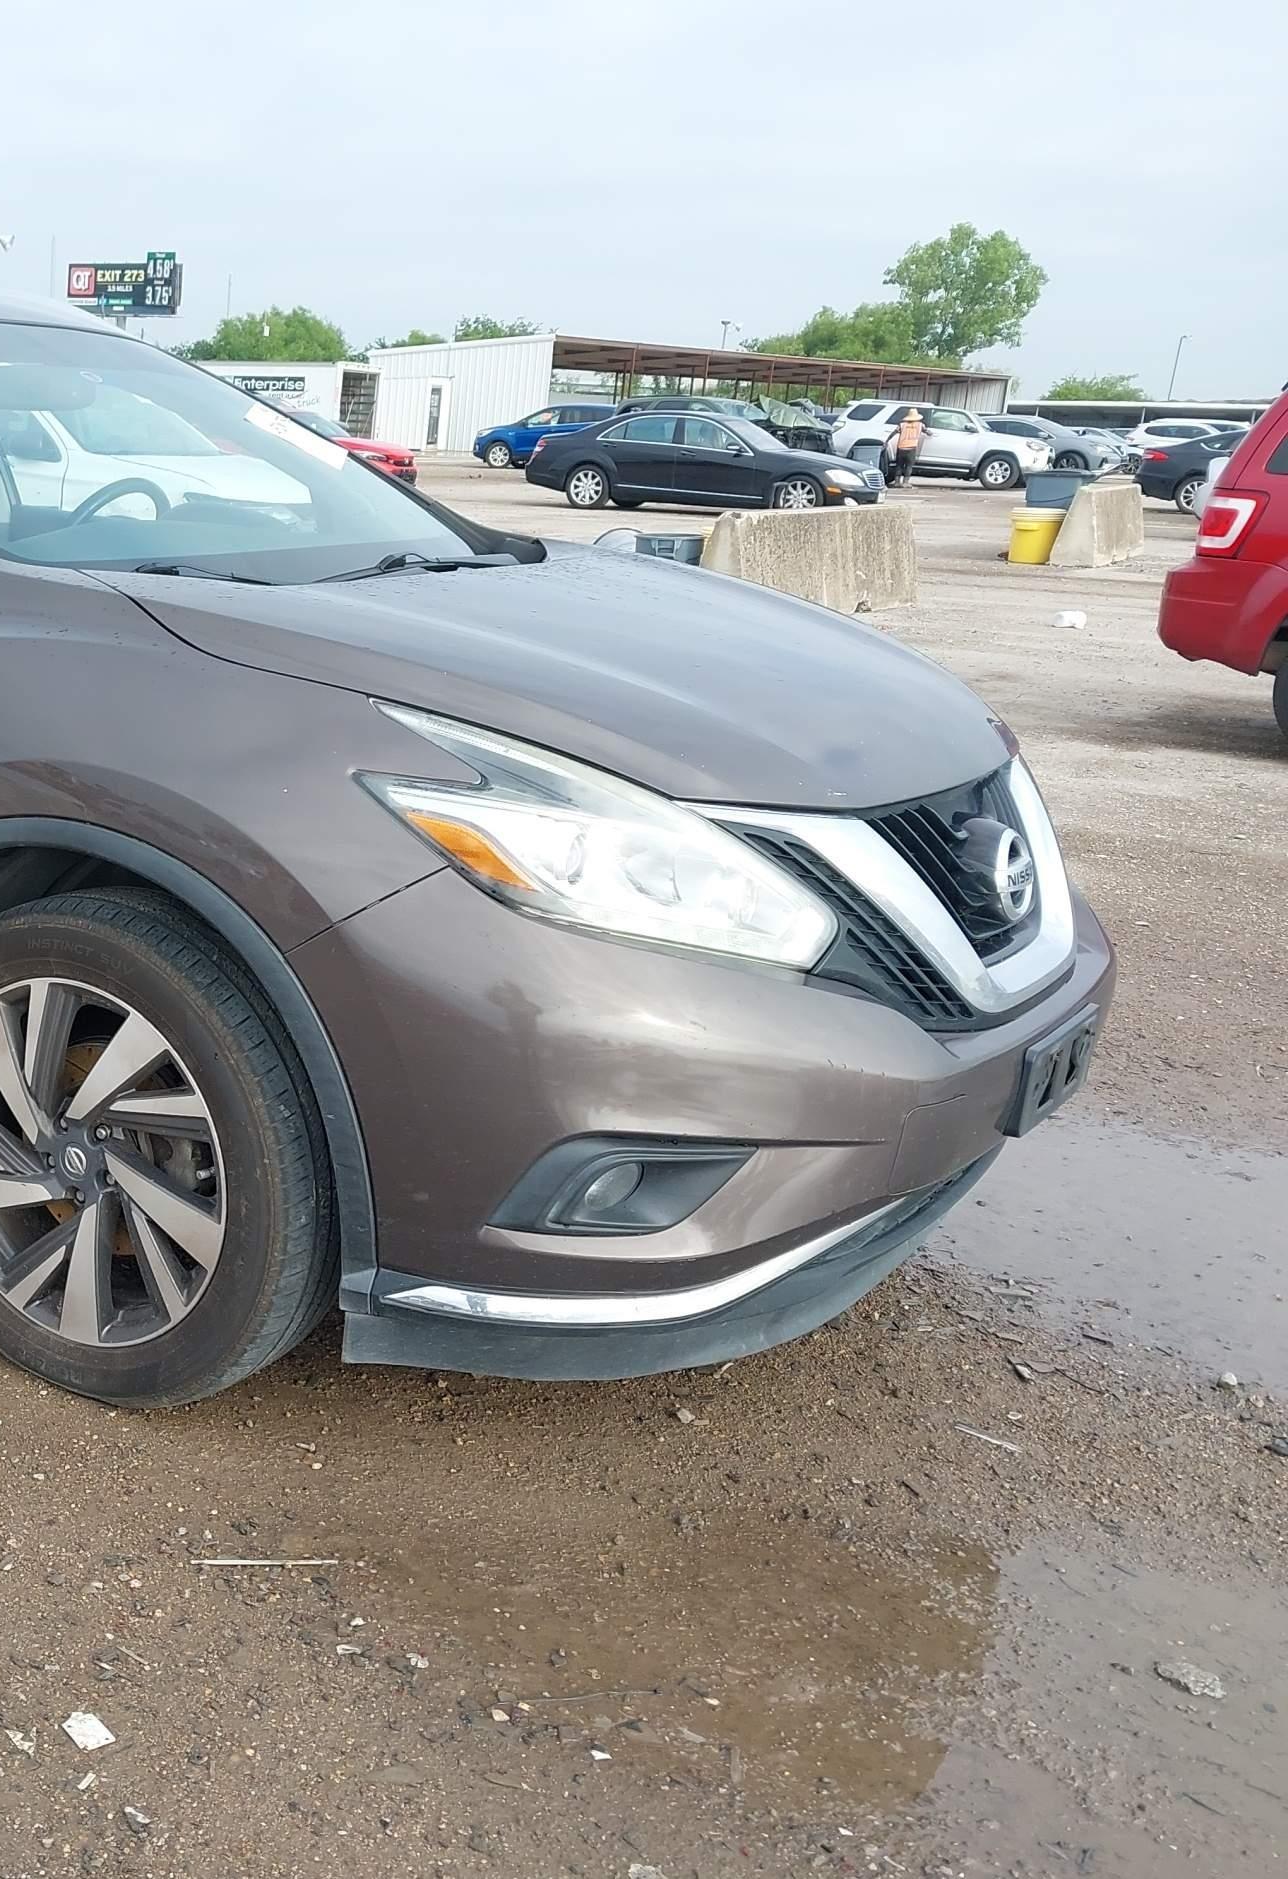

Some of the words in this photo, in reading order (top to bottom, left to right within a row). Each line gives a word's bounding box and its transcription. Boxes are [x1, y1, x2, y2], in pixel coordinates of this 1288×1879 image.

[73, 271, 90, 290] QT
[96, 270, 122, 282] EXIT
[124, 270, 145, 281] 273
[234, 378, 304, 391] Enterprise
